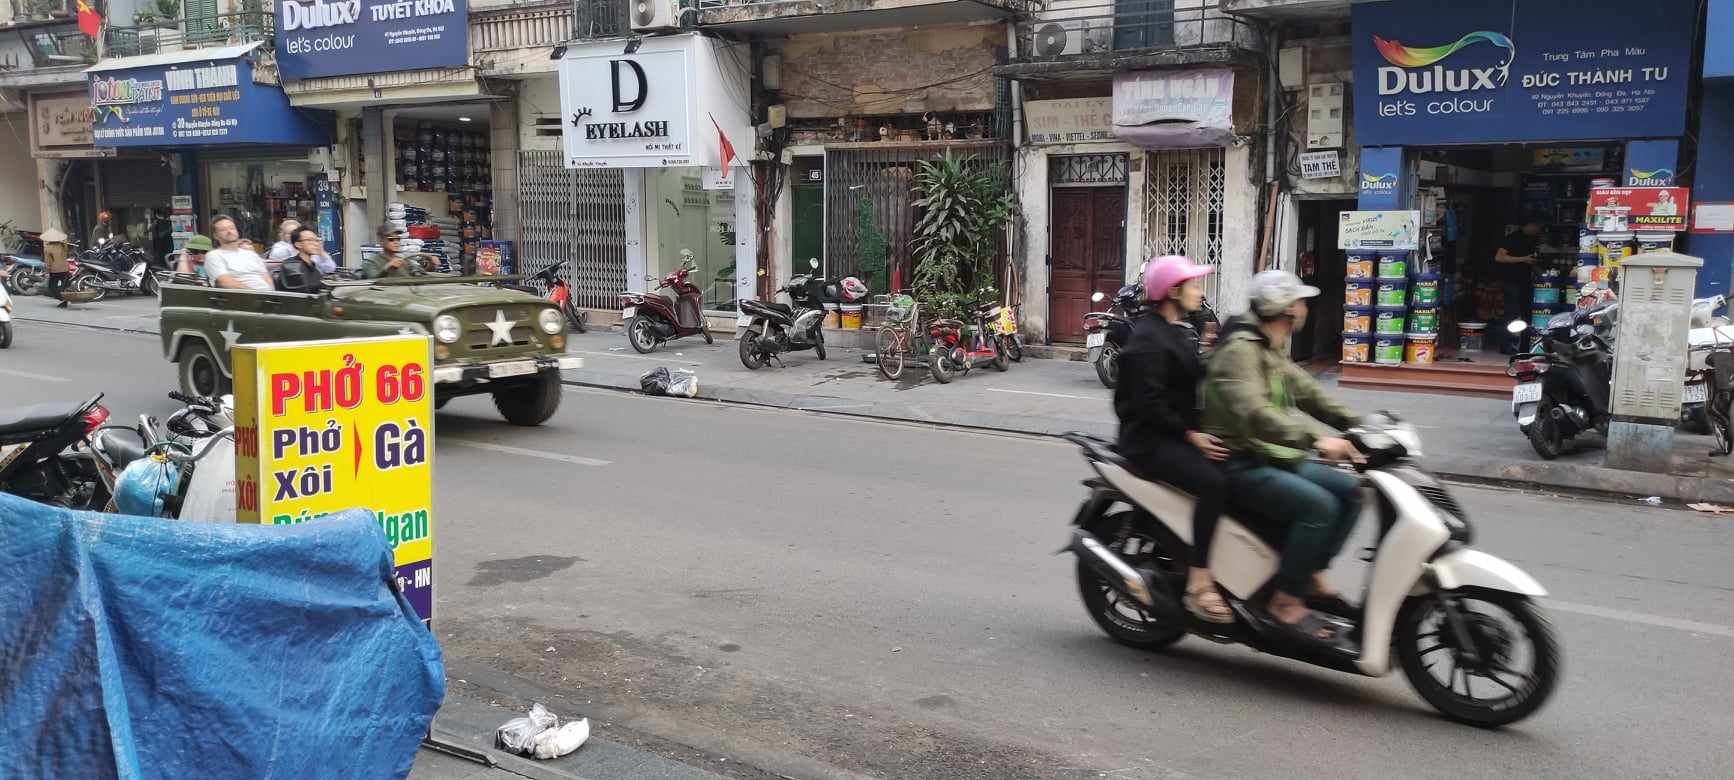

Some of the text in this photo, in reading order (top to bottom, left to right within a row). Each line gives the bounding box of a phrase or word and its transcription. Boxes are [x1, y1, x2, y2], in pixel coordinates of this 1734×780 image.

[282, 0, 355, 31] Dulux
[286, 33, 355, 55] let's colour
[1543, 52, 1569, 62] Trung
[1601, 48, 1619, 57] Pha
[609, 59, 648, 113] D
[1377, 65, 1497, 96] Dulux
[1522, 70, 1560, 88] ĐỨC
[1378, 98, 1494, 117] let's colour
[585, 121, 669, 140] EYELASH
[318, 180, 329, 191] 39
[1361, 180, 1392, 190] Dulux
[1629, 177, 1667, 187] Dulux
[1635, 215, 1682, 224] MAXILITE
[271, 353, 425, 417] PHỞ 66
[235, 418, 258, 458] PHỞ
[273, 420, 342, 460] Phở
[375, 418, 426, 469] Gà
[238, 474, 258, 513] XÔI
[274, 465, 332, 501] Xôi
[415, 566, 431, 589] HN
